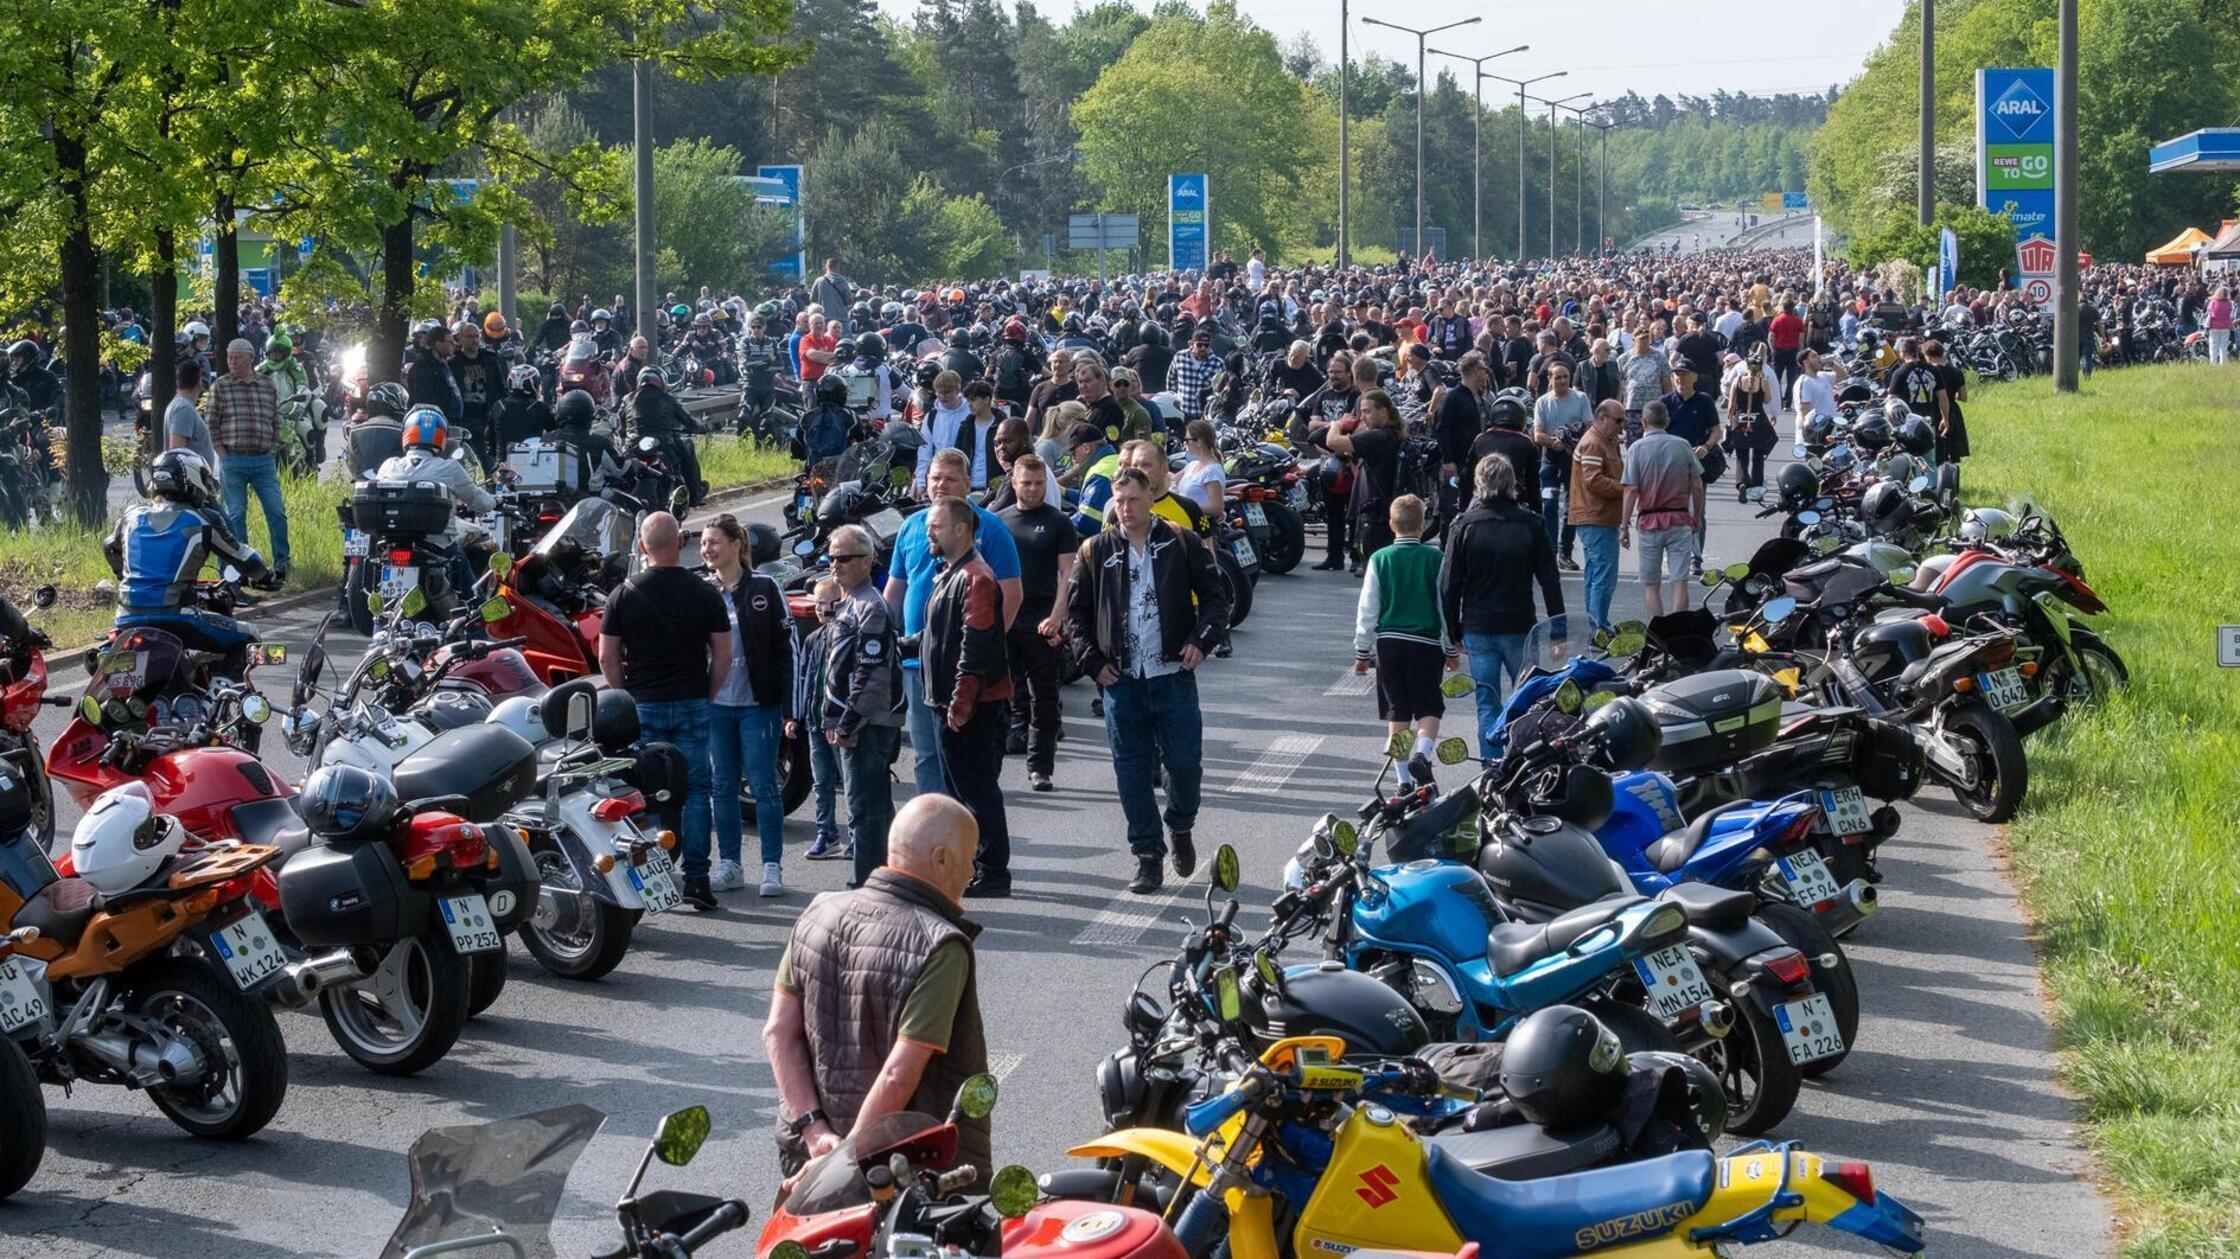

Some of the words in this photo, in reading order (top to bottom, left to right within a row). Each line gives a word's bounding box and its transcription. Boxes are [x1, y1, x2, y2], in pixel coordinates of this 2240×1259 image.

[1997, 99, 2041, 115] ARAL
[1993, 158, 2018, 166] REWE
[2002, 168, 2020, 179] TO
[2021, 155, 2048, 170] GO
[1177, 189, 1199, 197] ARAL
[2020, 246, 2055, 273] UTA
[2032, 286, 2045, 298] 10
[397, 568, 404, 577] N
[382, 588, 395, 597] MP
[1990, 672, 2003, 689] N
[2002, 685, 2028, 705] 642
[1834, 788, 1861, 804] ERH
[1838, 819, 1857, 832] CN
[1858, 817, 1867, 829] 6
[1788, 850, 1820, 870] NEA
[638, 860, 664, 880] LAU
[645, 896, 664, 913] LT
[664, 890, 680, 906] 66
[1797, 887, 1816, 904] FF
[1817, 881, 1838, 897] 94
[458, 899, 471, 914] N
[497, 895, 507, 913] D
[232, 923, 247, 940] N
[456, 934, 473, 950] PP
[474, 931, 499, 948] 252
[236, 964, 259, 986] WK
[256, 949, 286, 975] 124
[1651, 946, 1686, 971] NEA
[1658, 993, 1683, 1015] MN
[1680, 982, 1711, 1006] 154
[2, 1007, 25, 1029] AC
[25, 998, 43, 1018] 49
[1802, 1000, 1815, 1017] N
[1791, 1043, 1814, 1062] FA
[1814, 1033, 1842, 1055] 226
[1318, 1077, 1359, 1087] SUZUKI
[1575, 1200, 1695, 1250] SUZUKI
[1322, 1240, 1358, 1254] SUZU
